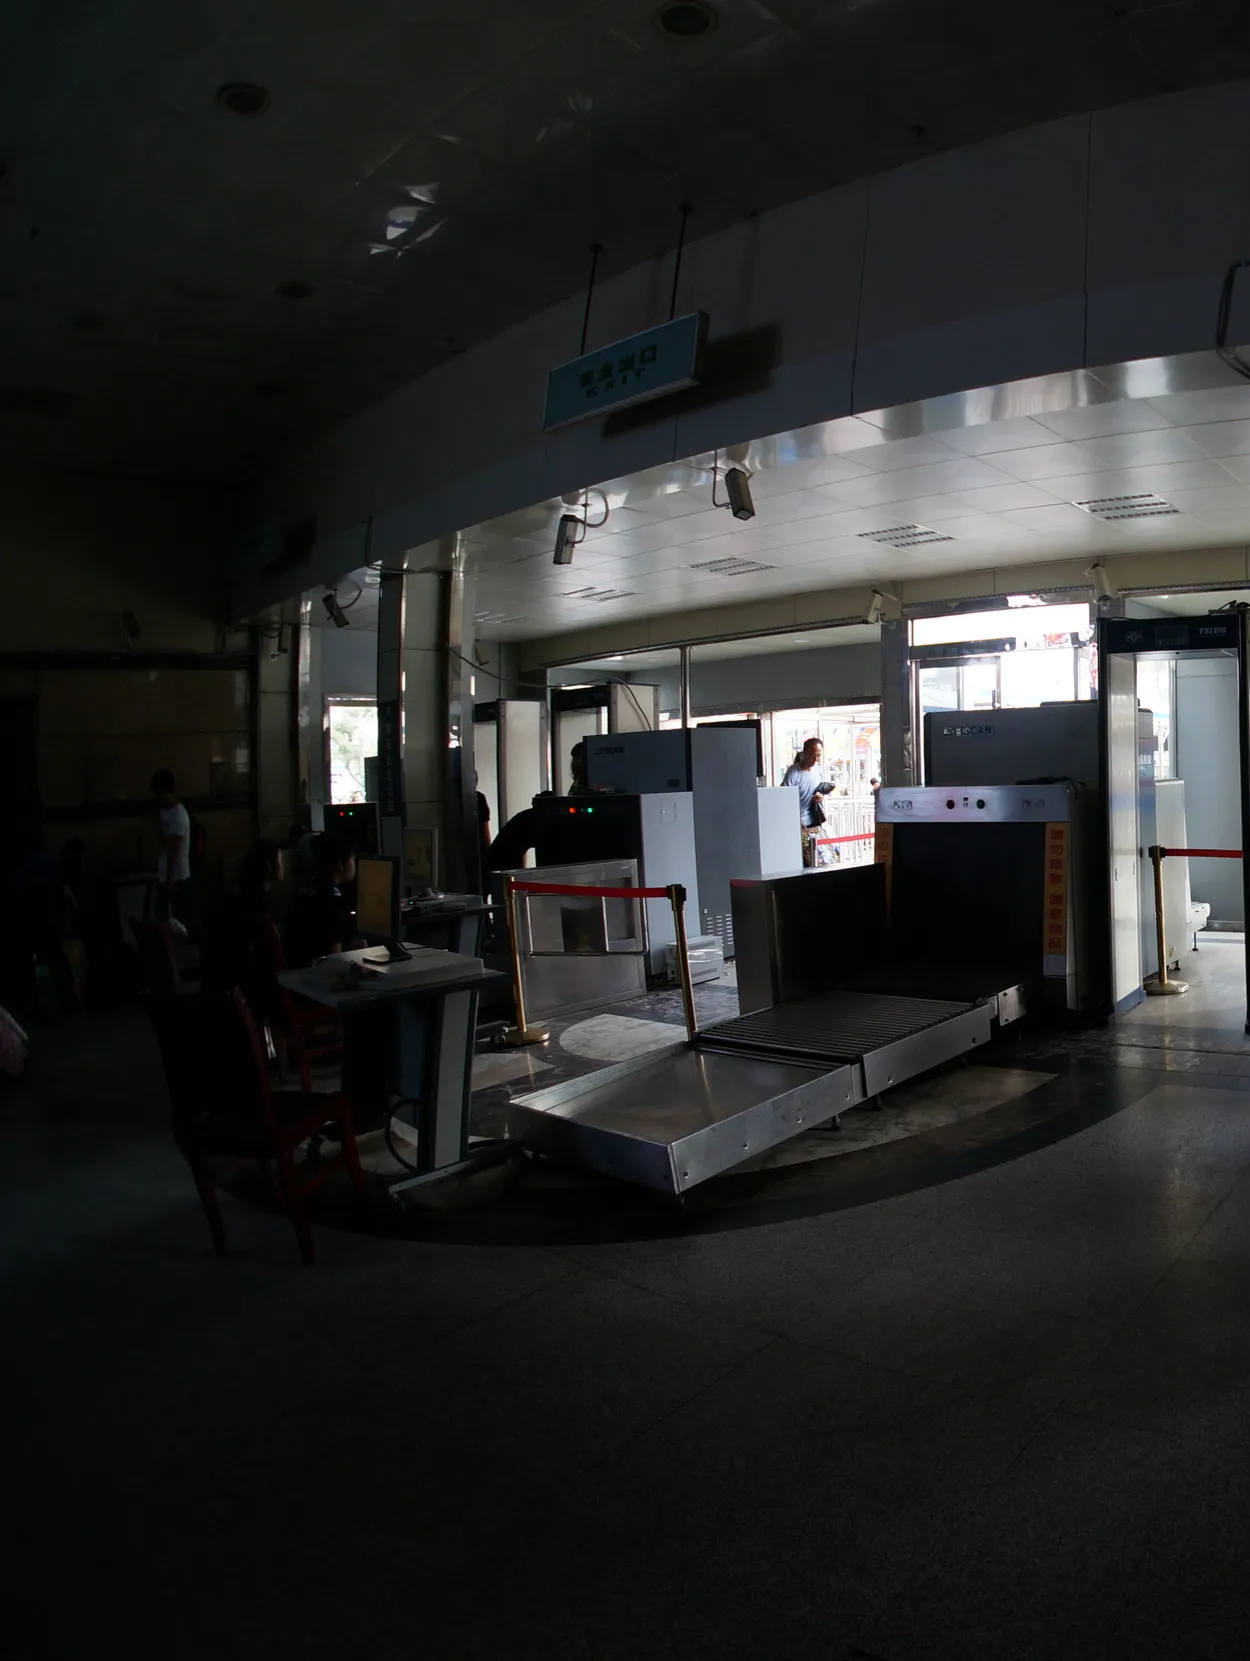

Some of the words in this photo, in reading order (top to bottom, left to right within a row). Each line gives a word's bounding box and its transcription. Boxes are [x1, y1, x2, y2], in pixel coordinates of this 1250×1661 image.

[580, 345, 657, 388] 安全出口
[586, 368, 646, 398] EXIT
